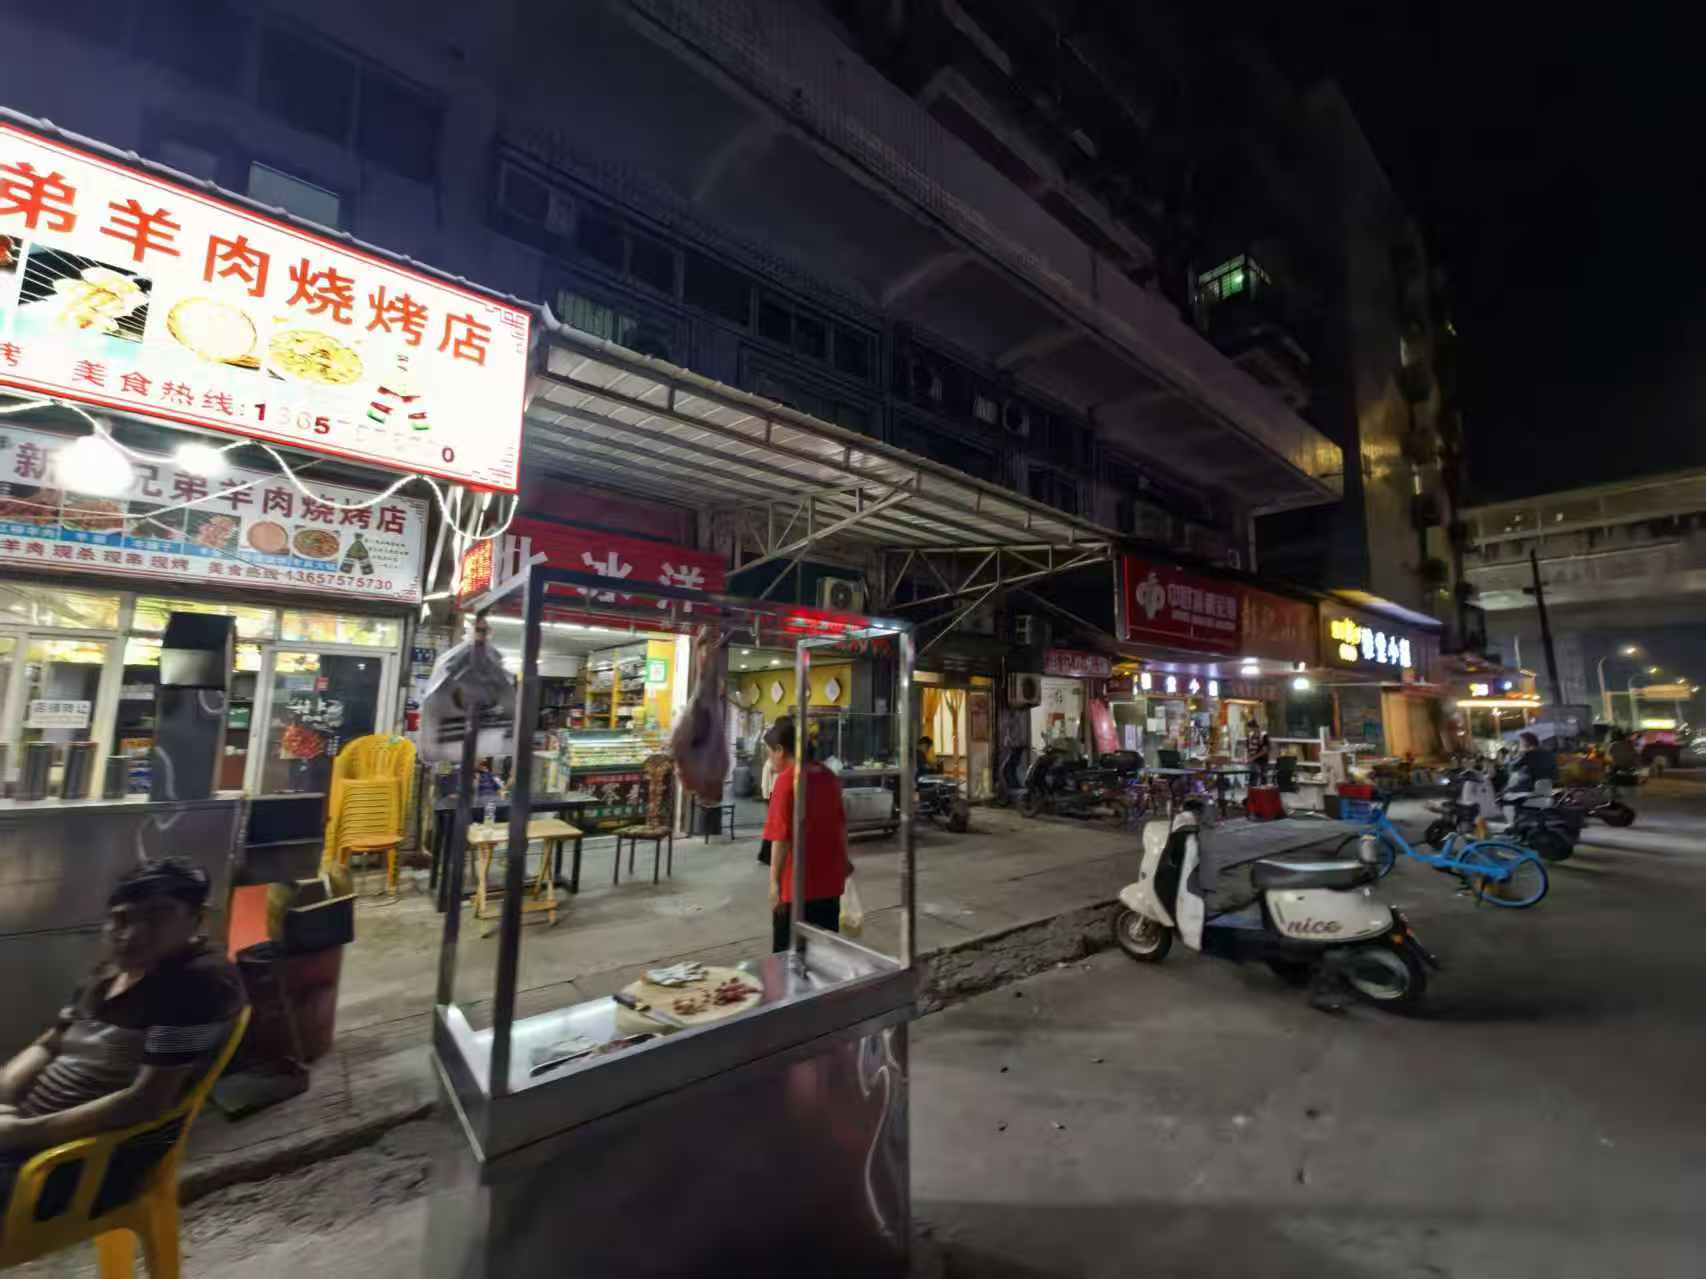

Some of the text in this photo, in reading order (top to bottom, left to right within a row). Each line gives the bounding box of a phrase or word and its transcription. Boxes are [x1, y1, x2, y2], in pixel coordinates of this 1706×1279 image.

[0, 162, 492, 366] 弟羊肉烧烤店
